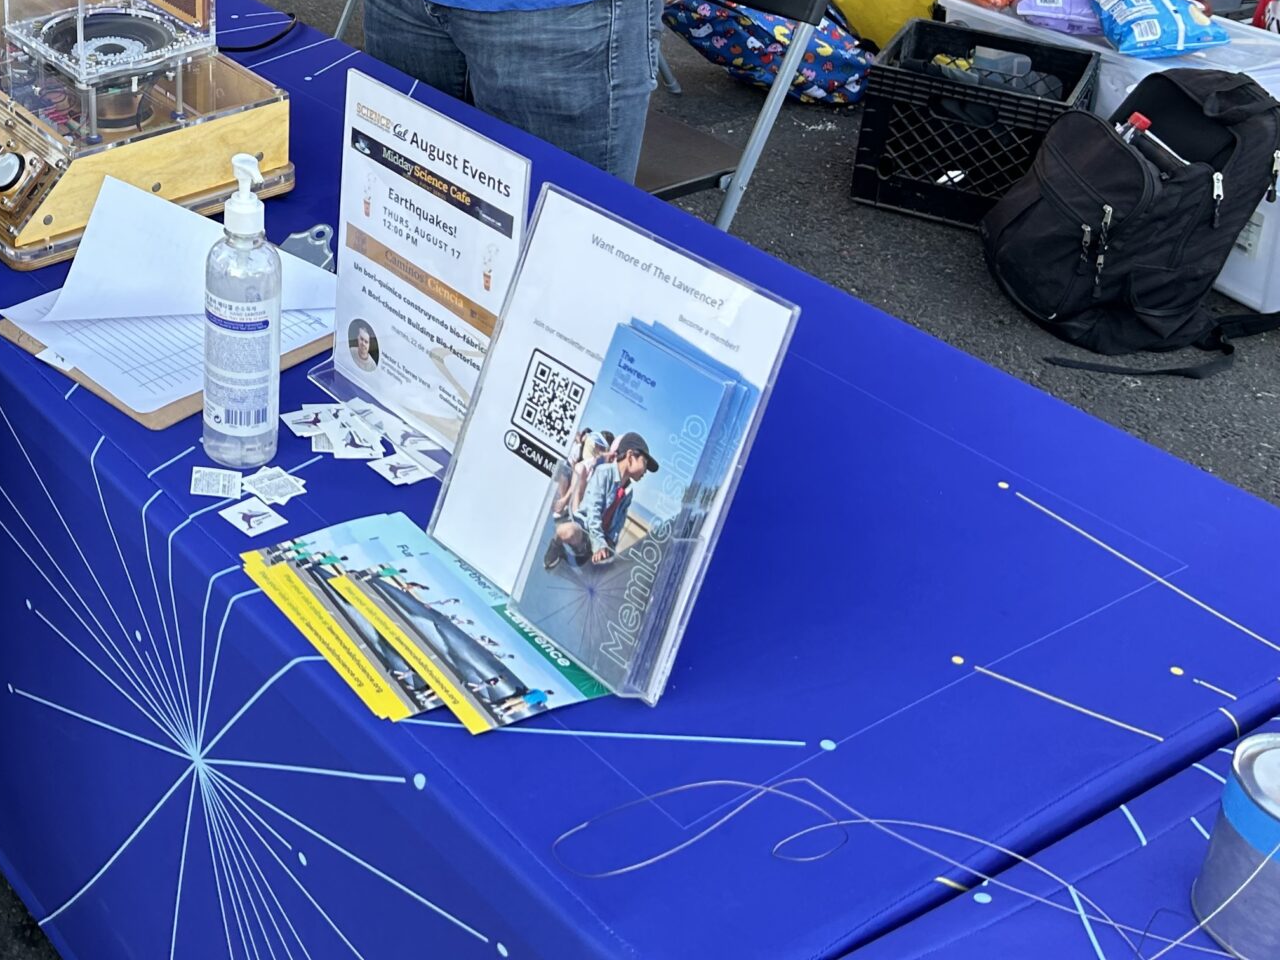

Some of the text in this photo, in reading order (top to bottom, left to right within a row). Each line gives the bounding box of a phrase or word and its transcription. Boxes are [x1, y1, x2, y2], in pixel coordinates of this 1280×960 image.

[382, 147, 414, 174] Midday
[413, 166, 449, 192] Science
[450, 186, 471, 206] Cafe
[410, 132, 458, 171] August
[462, 159, 511, 198] Events
[388, 187, 458, 238] Earthquakes!
[383, 218, 418, 247] 12:00 PM
[414, 227, 449, 255] AUGUST
[451, 248, 461, 260] 17
[591, 233, 725, 310] Want more of The Lawrence?
[353, 262, 362, 273] Un
[403, 294, 449, 331] construyendo
[427, 277, 464, 308] Ciencia
[361, 285, 367, 294] A
[368, 289, 407, 322] Bori-chemist
[407, 316, 435, 343] Building
[678, 314, 703, 333] Become
[555, 327, 586, 354] newsletter
[621, 349, 635, 364] The
[618, 358, 656, 388] Lawrence
[521, 444, 543, 465] SCAN
[600, 414, 708, 669] Membership
